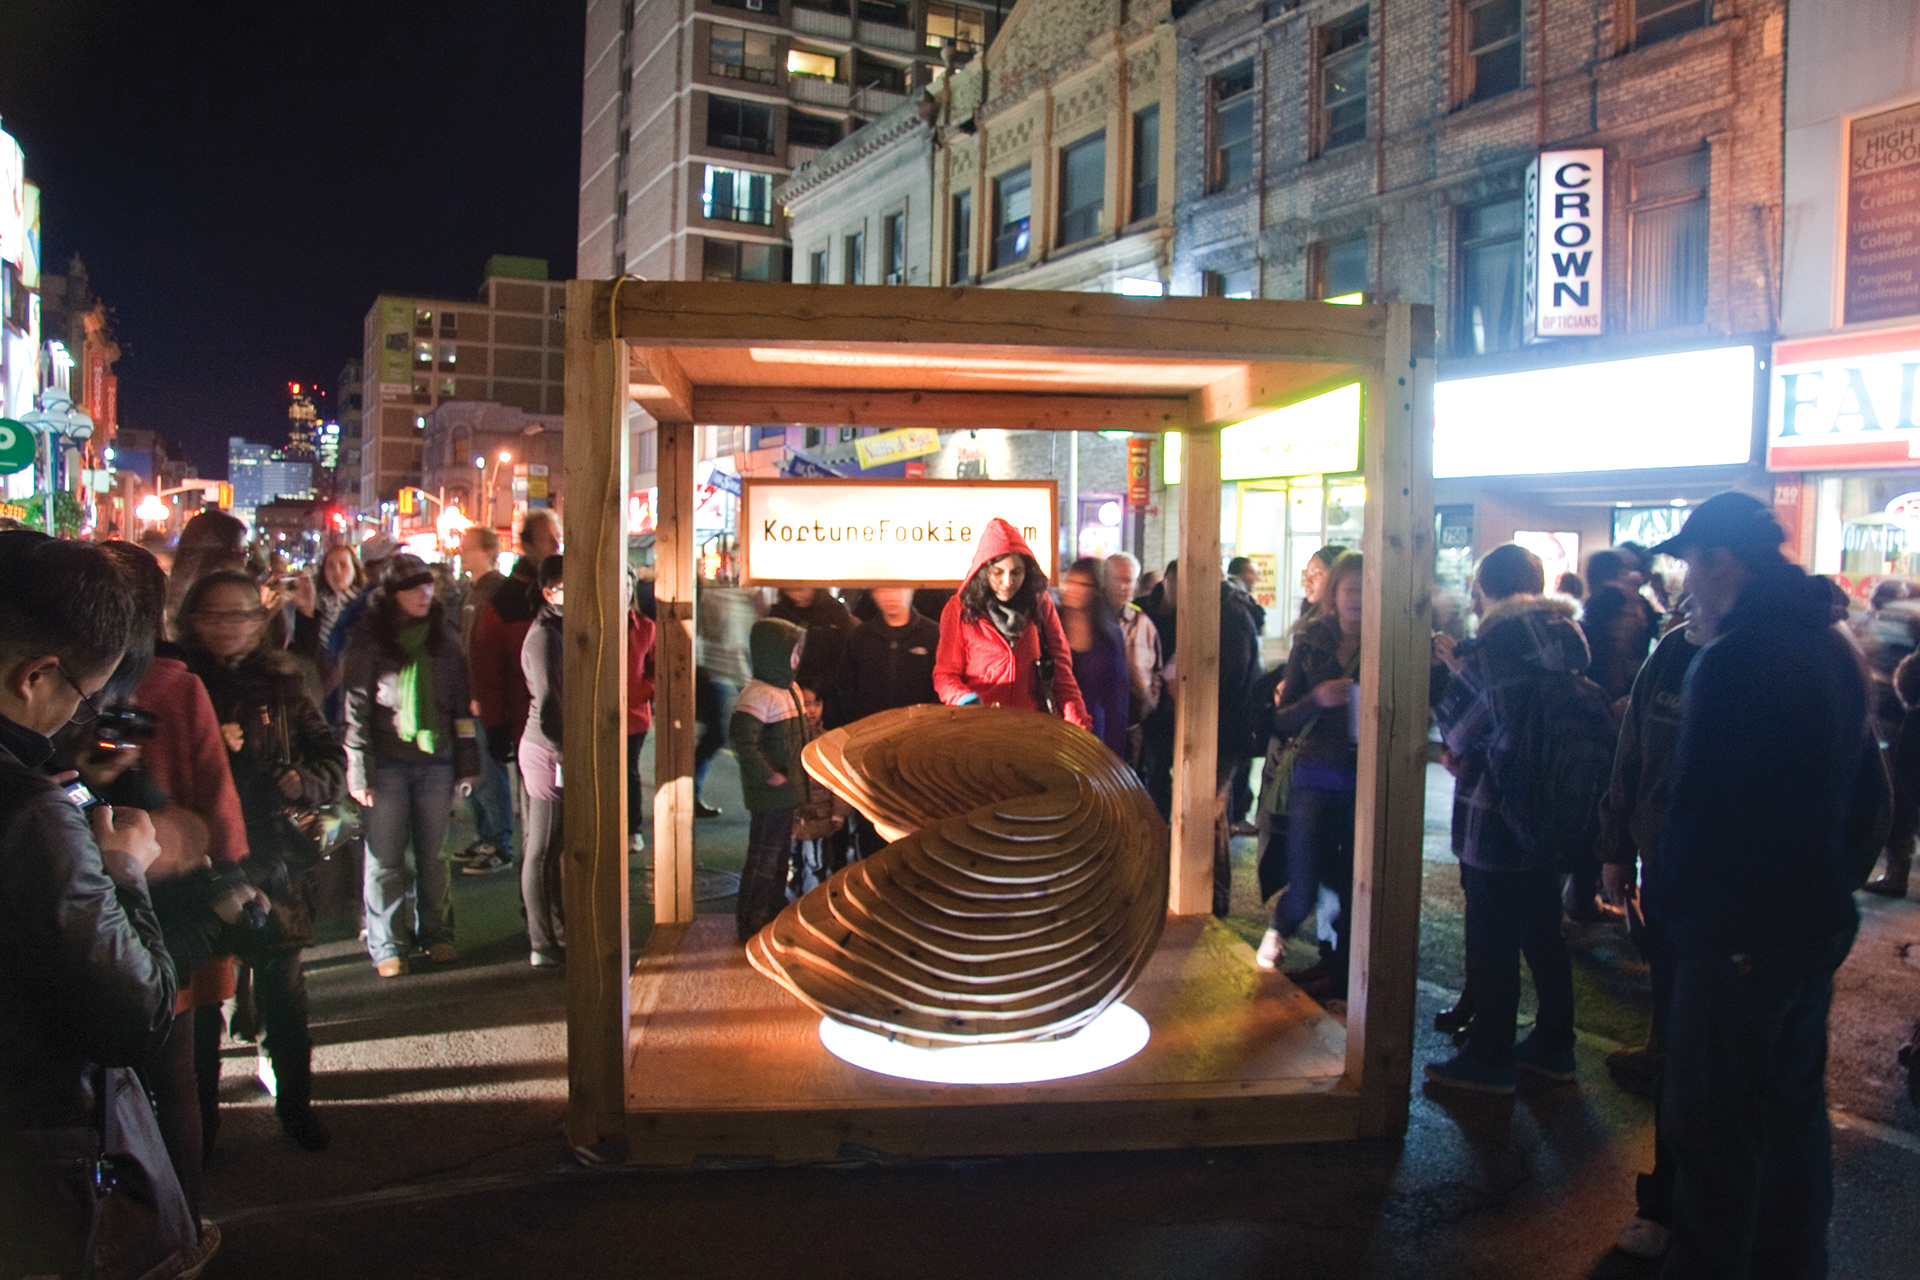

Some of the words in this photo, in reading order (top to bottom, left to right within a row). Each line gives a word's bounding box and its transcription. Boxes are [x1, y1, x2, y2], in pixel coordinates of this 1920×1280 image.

[1867, 128, 1914, 153] HIGH
[1854, 142, 1920, 173] SCHOO
[1860, 188, 1916, 211] Credits
[1551, 162, 1592, 307] CROWN
[1859, 230, 1912, 250] College
[1542, 314, 1599, 330] OPTICIANS
